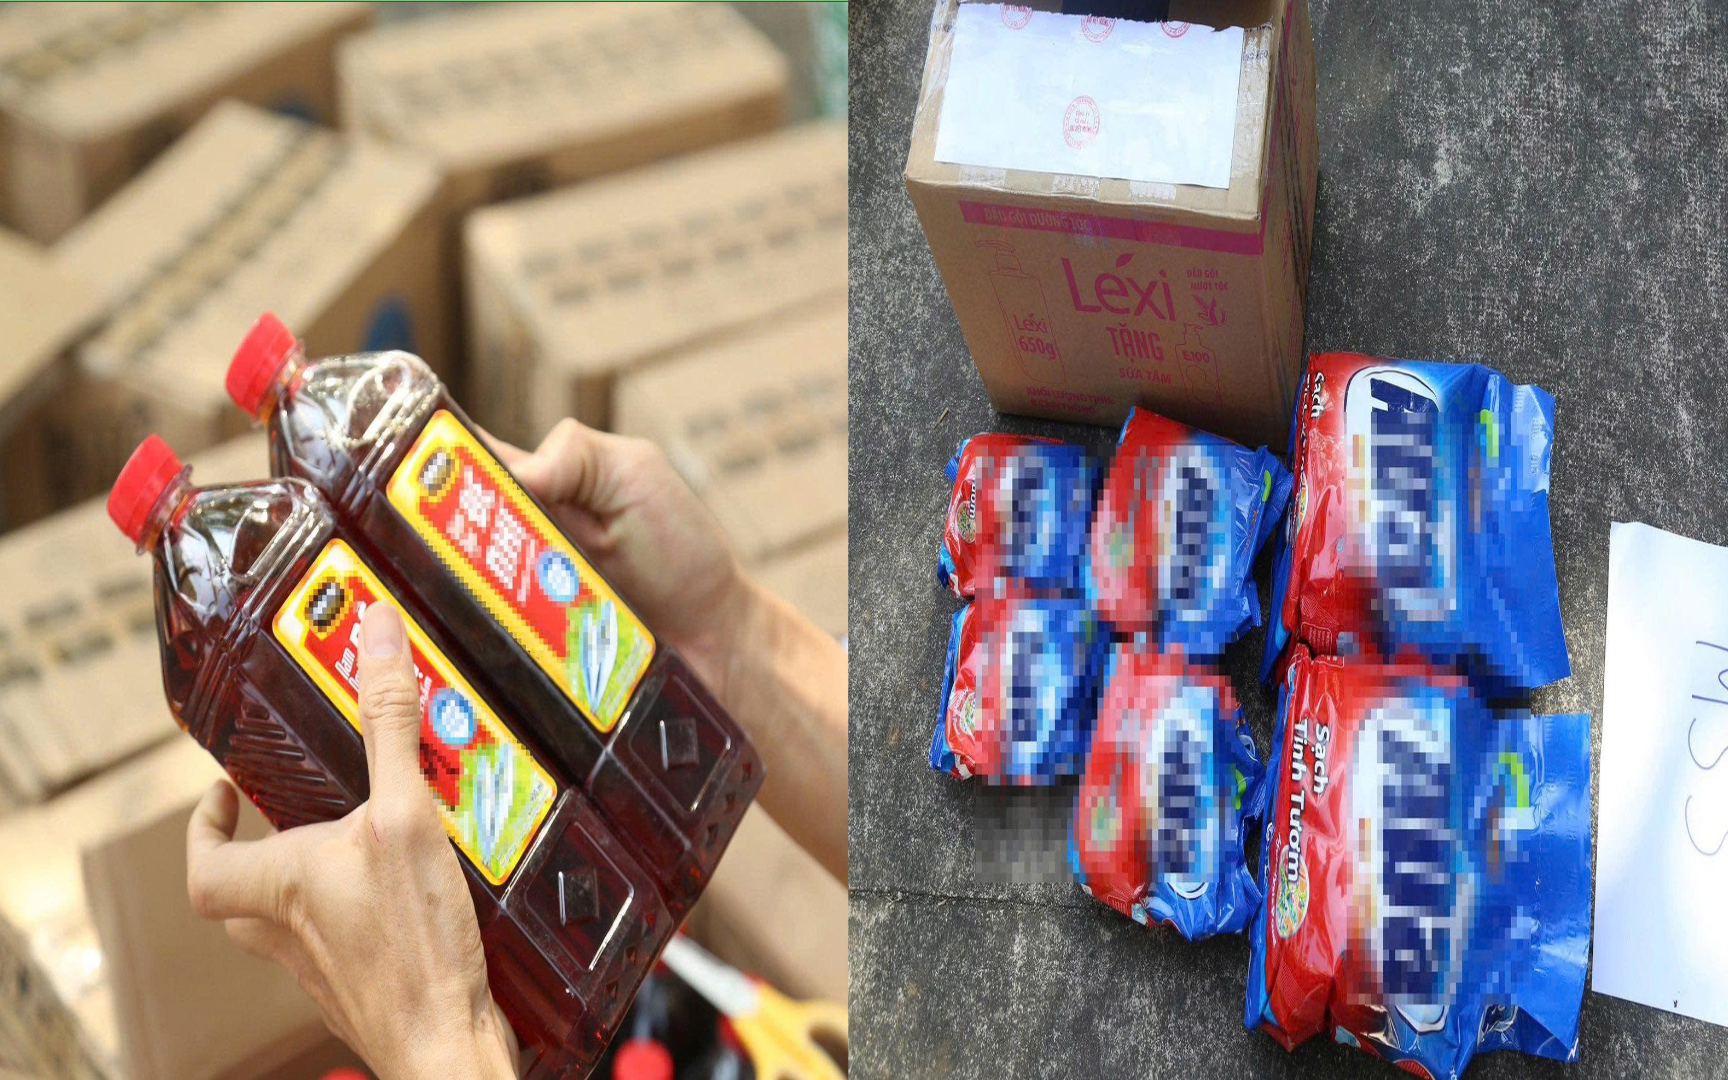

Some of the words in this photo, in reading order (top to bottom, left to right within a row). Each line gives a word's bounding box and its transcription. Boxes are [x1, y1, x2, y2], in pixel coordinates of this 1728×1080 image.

[1018, 336, 1057, 360] 650g
[1106, 323, 1165, 363] TẶNG
[1291, 719, 1308, 781] Tinh
[1312, 723, 1330, 795] Sạch
[1287, 790, 1305, 883] Tươm
